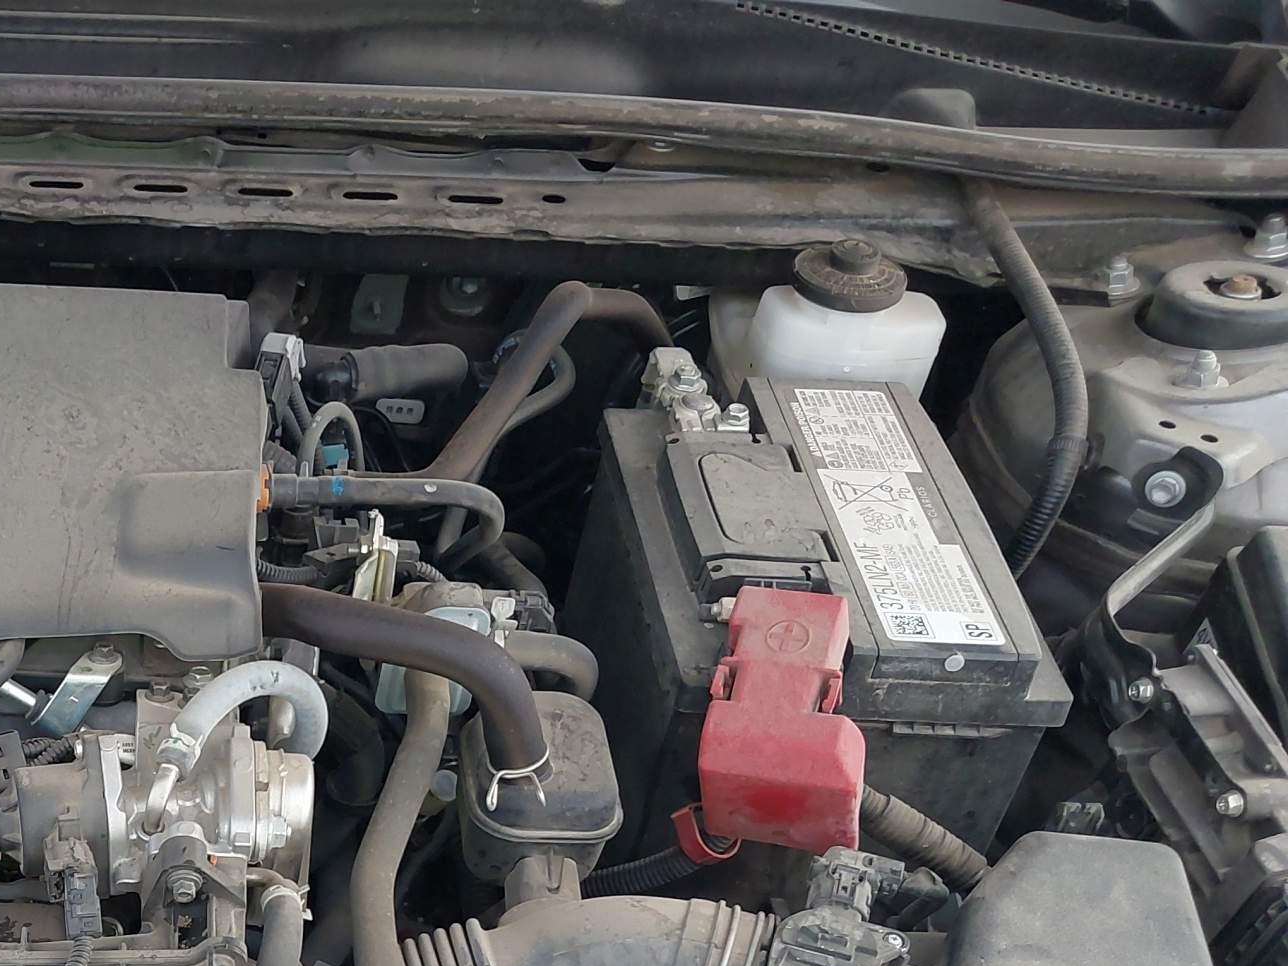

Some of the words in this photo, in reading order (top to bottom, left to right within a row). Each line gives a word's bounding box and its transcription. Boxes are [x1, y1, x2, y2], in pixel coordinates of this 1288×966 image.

[896, 487, 914, 500] Pb
[854, 542, 904, 610] 375LN2-MF
[965, 623, 993, 639] SP
